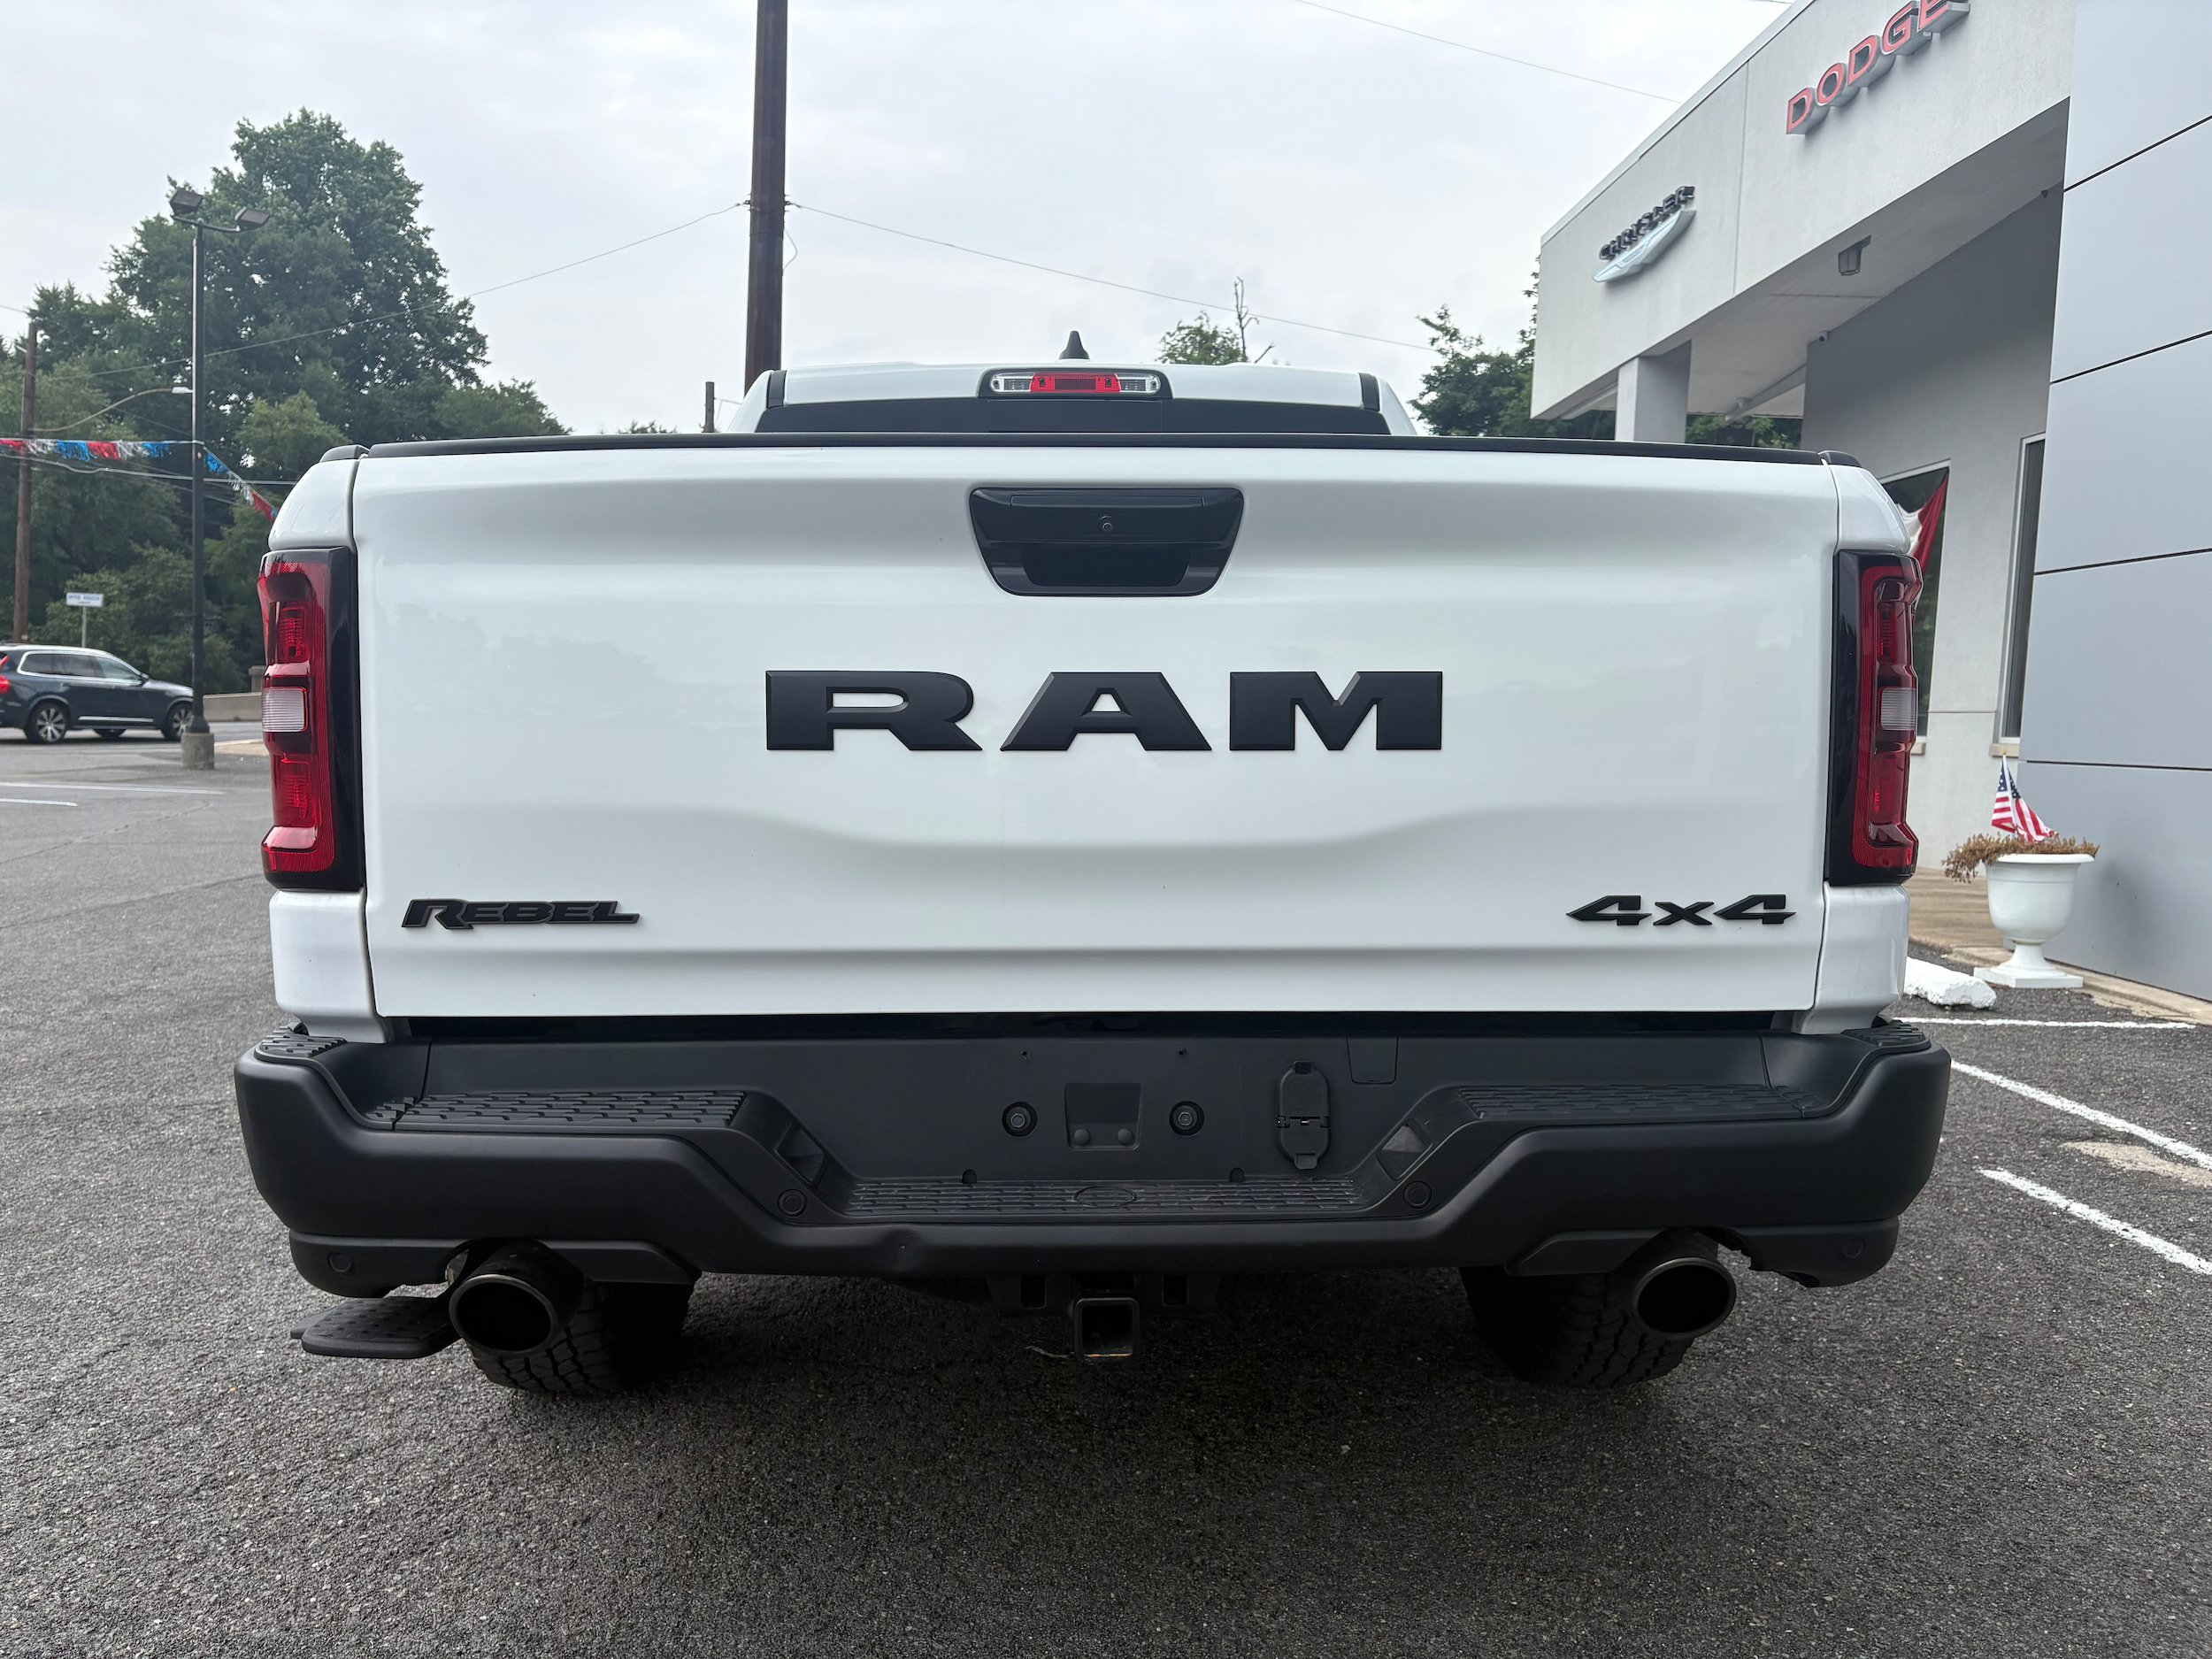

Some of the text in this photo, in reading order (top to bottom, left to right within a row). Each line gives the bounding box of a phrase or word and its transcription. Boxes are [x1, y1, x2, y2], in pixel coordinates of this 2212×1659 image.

[1786, 0, 1955, 134] DODGE
[1600, 186, 1695, 260] CHRYSLER
[766, 670, 1443, 750] RAM
[401, 898, 640, 929] REBEL
[1565, 895, 1797, 926] 4x4
